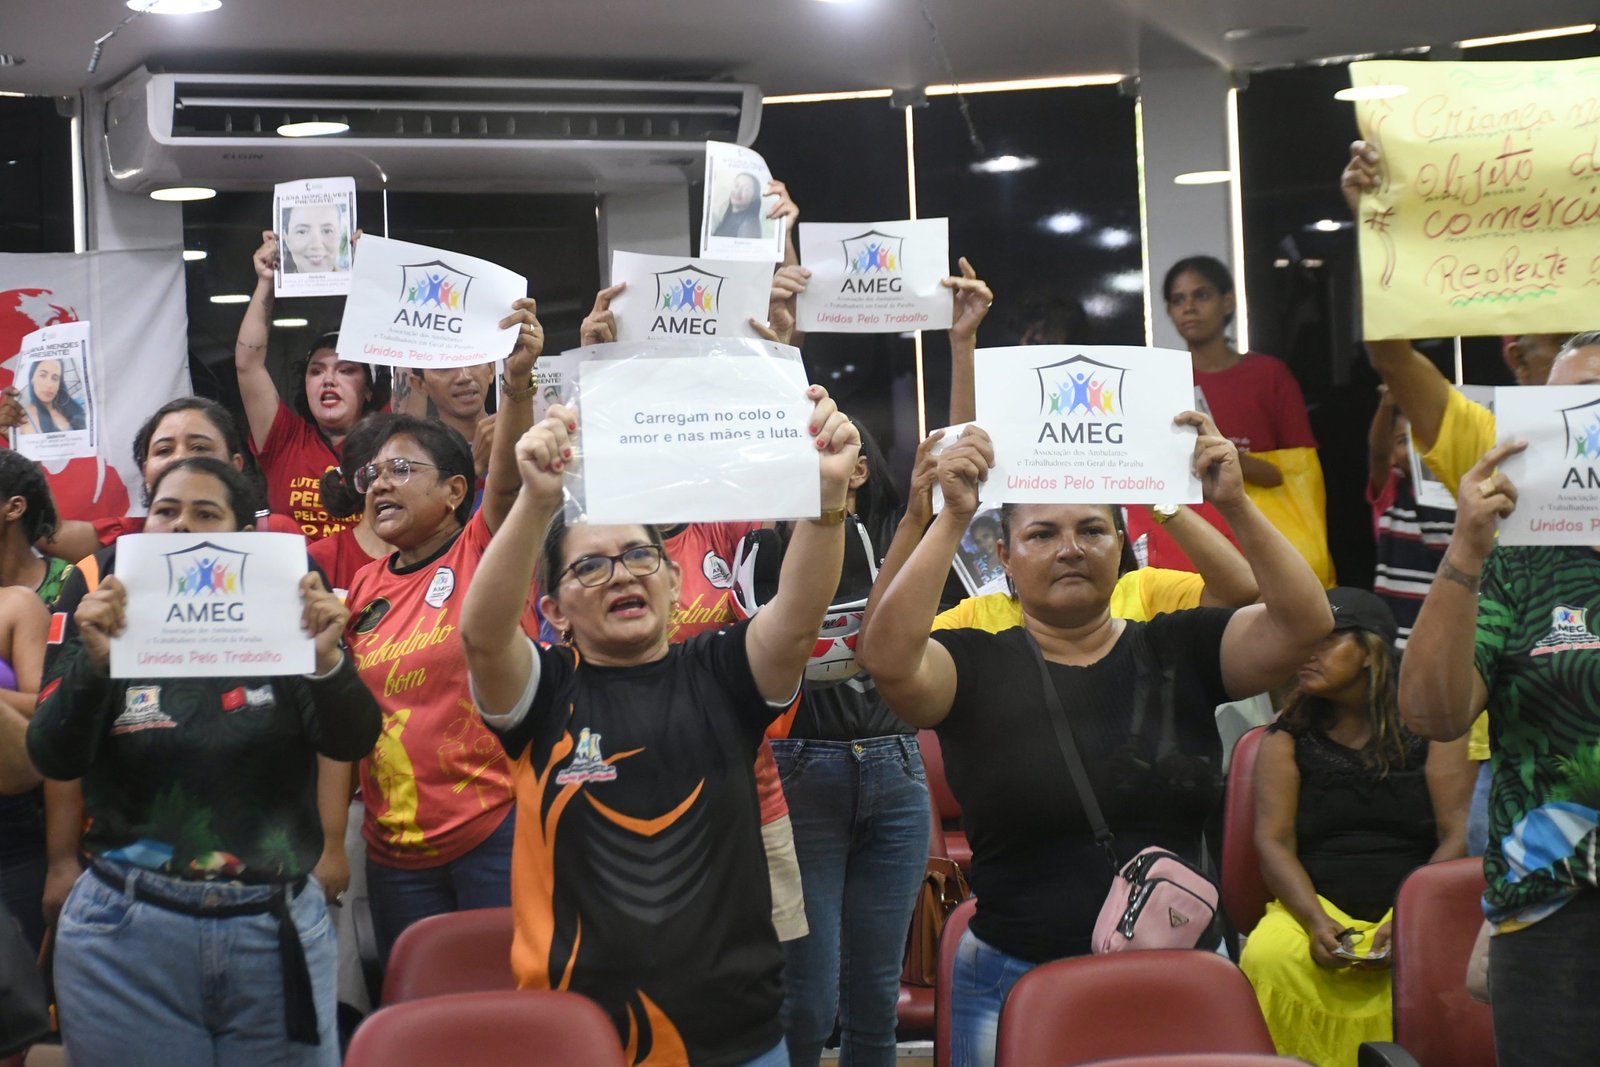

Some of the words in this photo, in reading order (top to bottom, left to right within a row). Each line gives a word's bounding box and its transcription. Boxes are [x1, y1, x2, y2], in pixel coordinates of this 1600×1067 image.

[1413, 94, 1555, 140] Criança
[1416, 134, 1533, 206] Objeto
[841, 277, 902, 293] AMEG
[394, 308, 463, 334] AMEG
[651, 316, 717, 335] AMEG
[817, 312, 853, 324] Unidos
[857, 313, 880, 324] Pelo
[884, 312, 929, 324] Trabalho
[363, 344, 404, 358] Unidos
[408, 350, 433, 361] Pelo
[440, 353, 488, 361] Trabalho
[634, 411, 709, 426] Carregam
[714, 411, 734, 421] no
[738, 408, 771, 420] colo
[776, 410, 786, 420] o
[619, 432, 659, 444] amor
[663, 432, 672, 442] e
[677, 431, 705, 442] nas
[710, 428, 751, 440] mãos
[756, 429, 765, 438] a
[770, 427, 802, 438] luta.
[1038, 422, 1124, 444] AMEG
[290, 477, 320, 489] LUTE
[1007, 475, 1057, 490] Unidos
[1063, 475, 1095, 490] Pelo
[1101, 476, 1165, 490] Trabalho
[289, 491, 323, 507] PEL
[294, 510, 328, 521] PELO
[1530, 518, 1583, 532] Unidos
[166, 602, 244, 623] AMEG
[137, 652, 184, 664] Unidos
[189, 650, 218, 664] Pelo
[224, 650, 282, 664] Trabalho
[384, 658, 427, 698] bom
